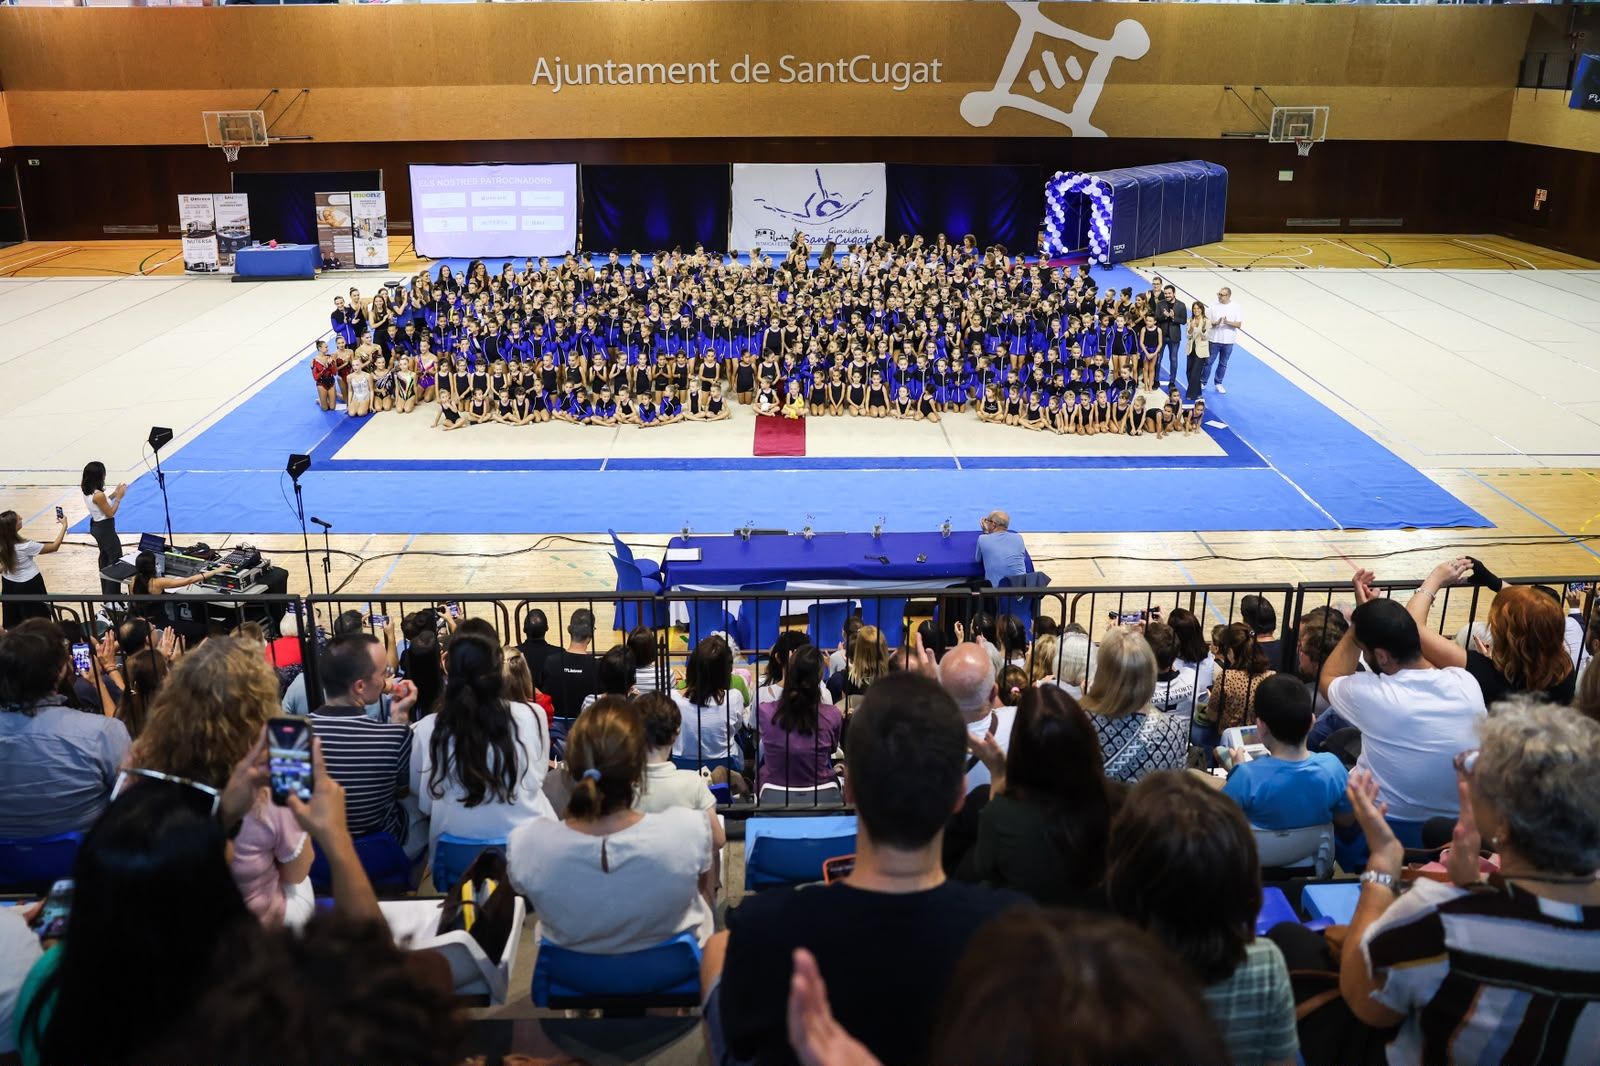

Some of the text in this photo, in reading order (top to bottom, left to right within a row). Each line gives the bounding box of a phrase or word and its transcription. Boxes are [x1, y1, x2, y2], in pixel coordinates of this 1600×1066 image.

[531, 54, 943, 93] Ajuntament de SantCugat
[436, 177, 478, 186] NOSTRES
[480, 176, 553, 185] PATROCINADORS
[804, 233, 872, 245] Sant Cugat
